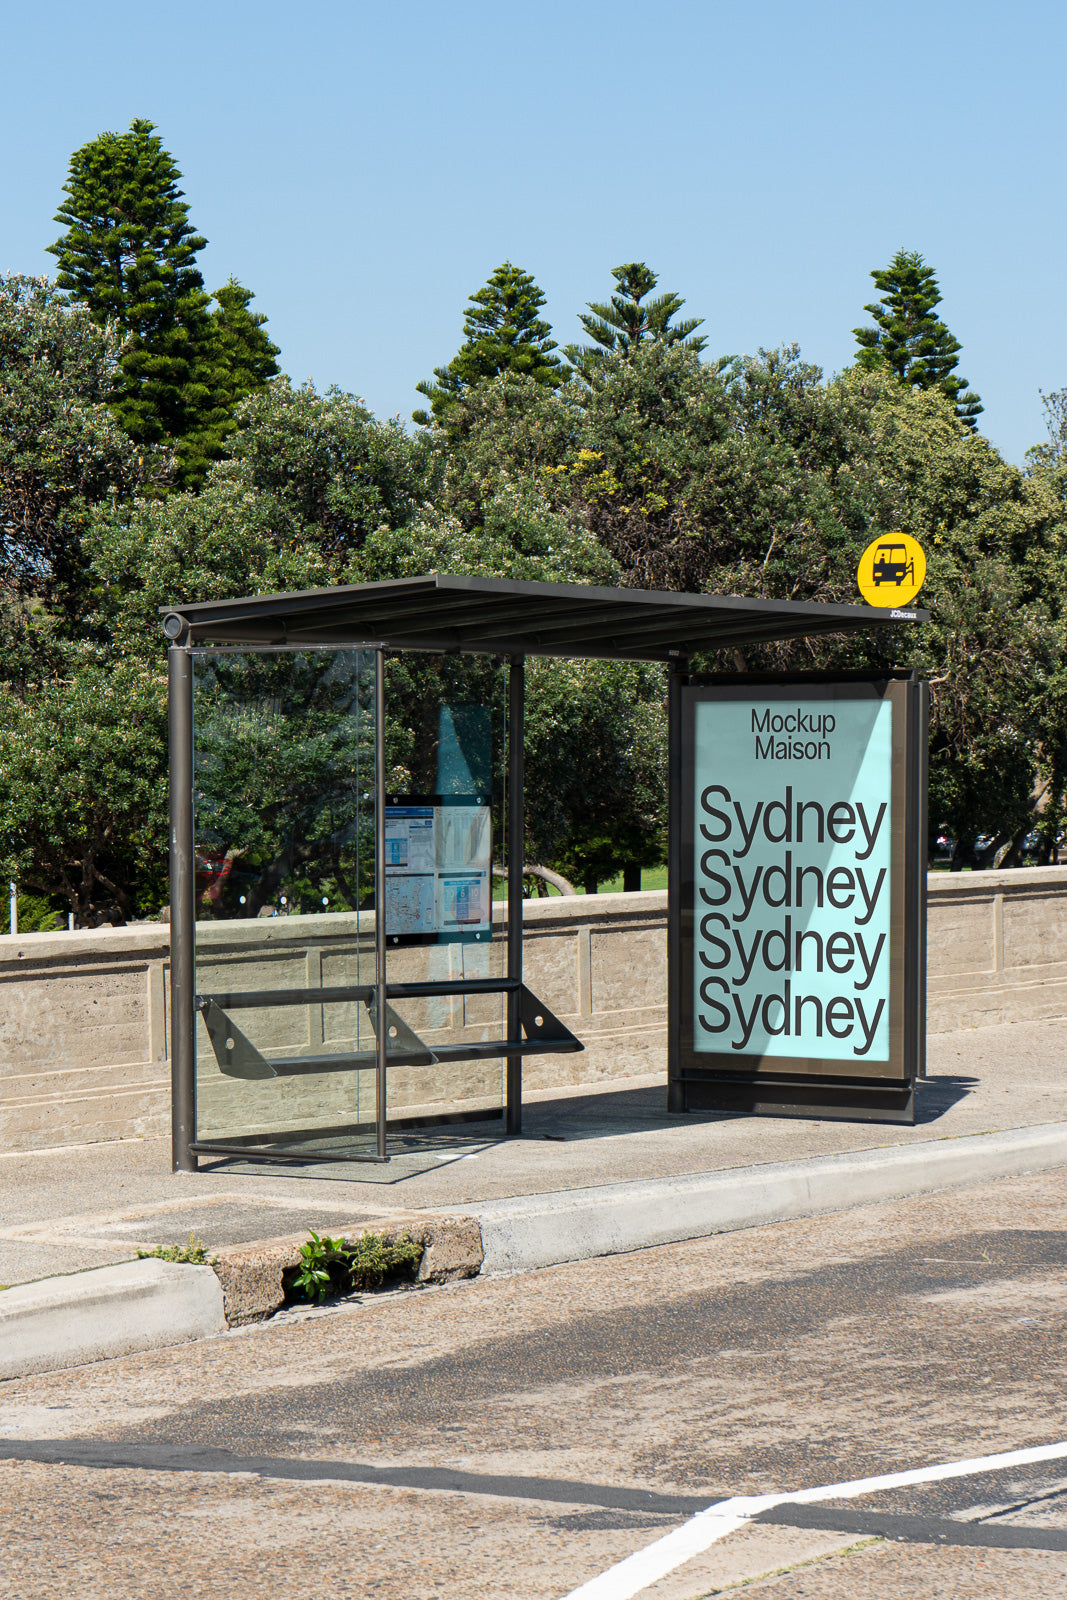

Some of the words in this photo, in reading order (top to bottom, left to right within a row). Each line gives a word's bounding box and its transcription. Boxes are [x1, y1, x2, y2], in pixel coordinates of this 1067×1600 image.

[890, 610, 917, 619] JCDecaux
[751, 708, 836, 739] Mockup
[755, 735, 831, 760] Maison
[699, 785, 888, 861] Sydney
[699, 849, 887, 926] Sydney
[699, 912, 887, 991] Sydney
[698, 976, 886, 1056] Sydney
